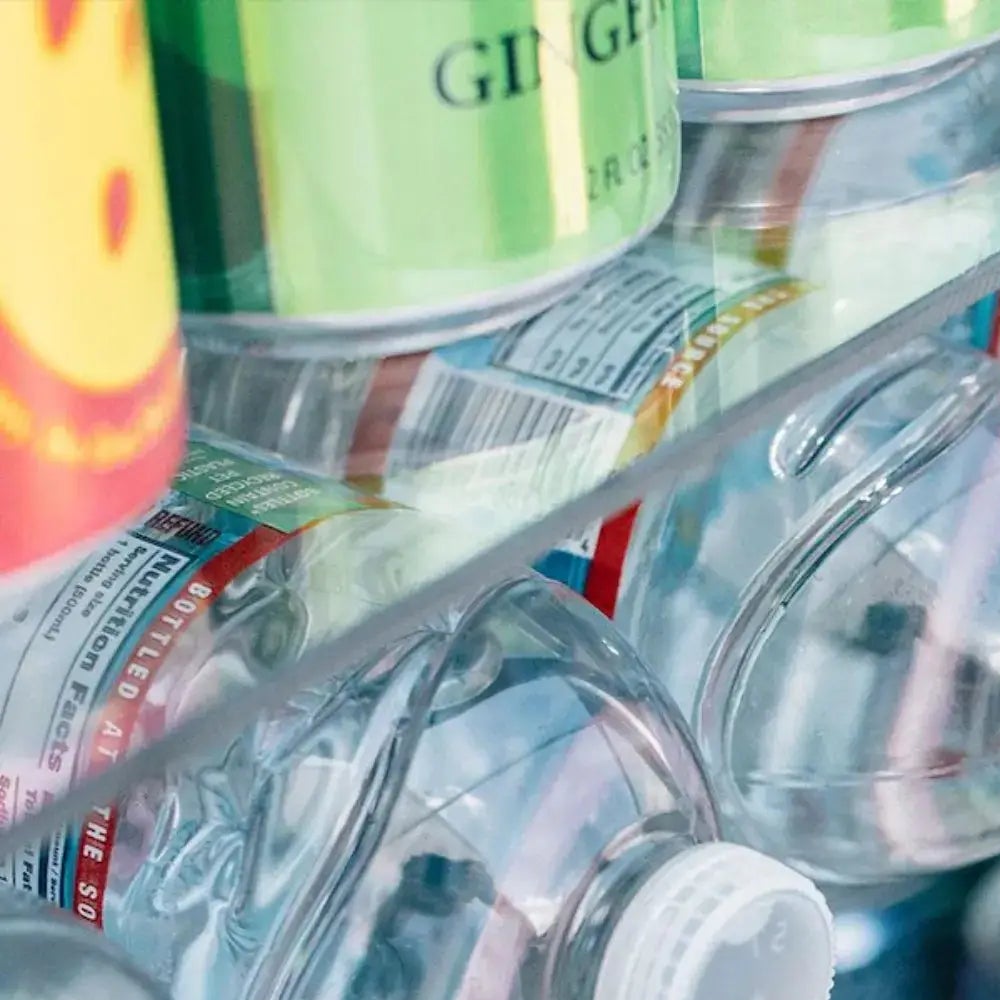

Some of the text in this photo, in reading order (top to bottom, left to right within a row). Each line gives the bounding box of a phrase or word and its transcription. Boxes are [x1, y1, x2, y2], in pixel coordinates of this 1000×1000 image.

[80, 546, 148, 619] Serving size
[83, 548, 121, 583] bottle
[48, 553, 181, 773] Nutrition Facts
[118, 582, 213, 700] BOTTLED
[97, 720, 123, 764] AT
[82, 805, 112, 863] THE
[22, 860, 34, 892] Fat
